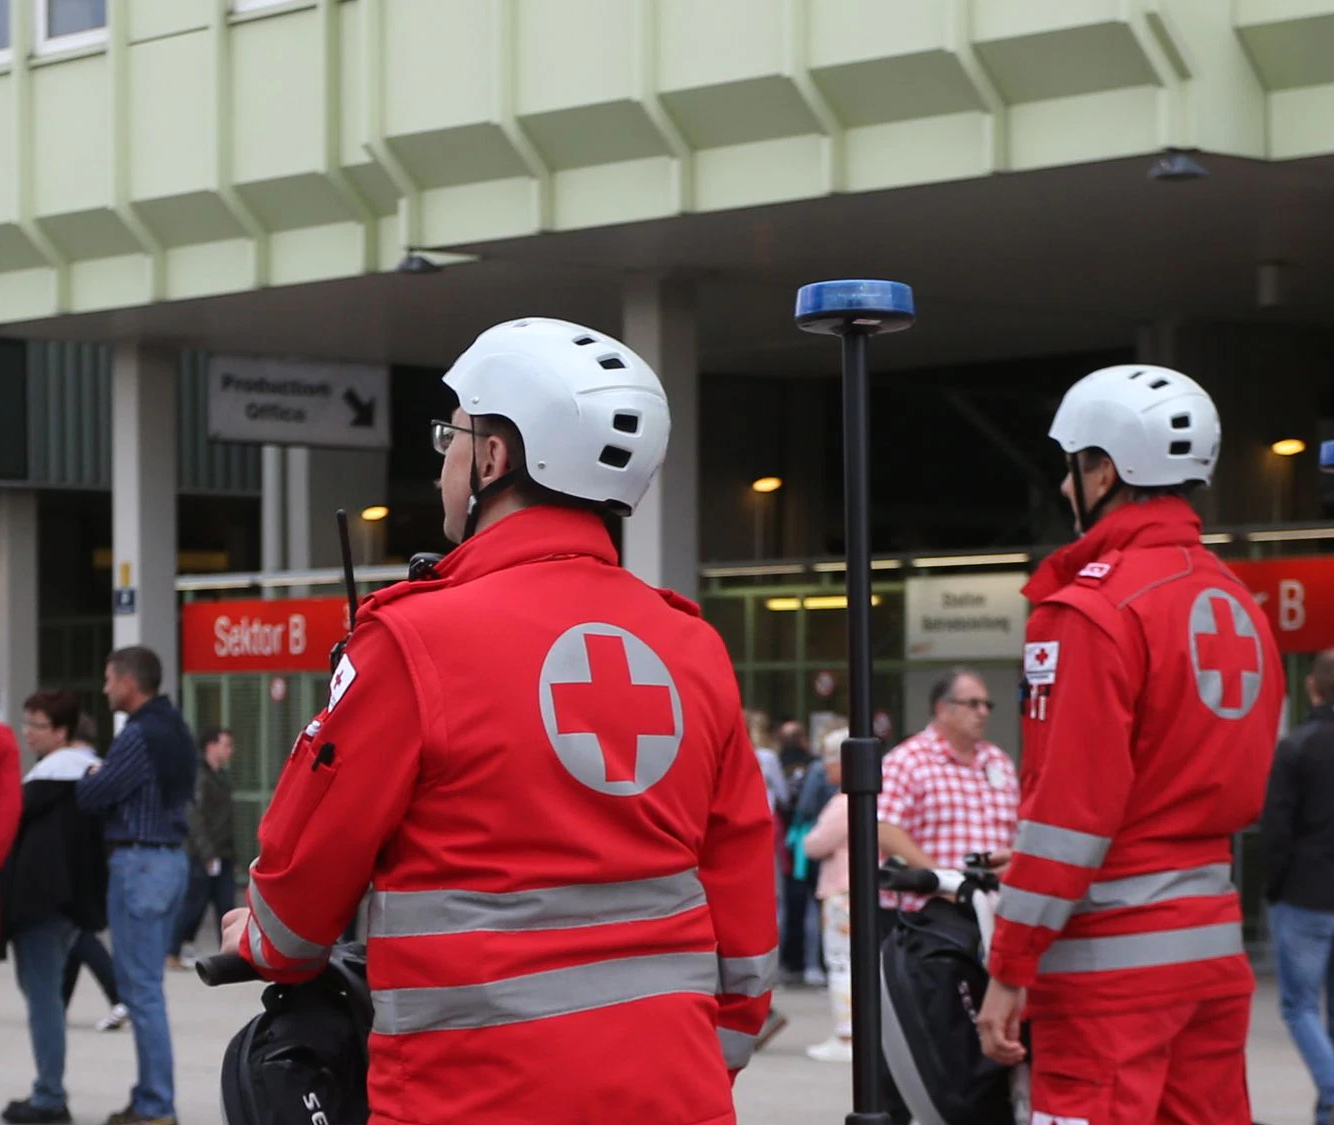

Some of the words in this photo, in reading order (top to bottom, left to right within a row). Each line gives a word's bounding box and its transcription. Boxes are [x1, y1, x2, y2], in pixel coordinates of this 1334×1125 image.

[1278, 579, 1306, 631] B
[214, 615, 285, 658] Sektor
[288, 613, 307, 656] B
